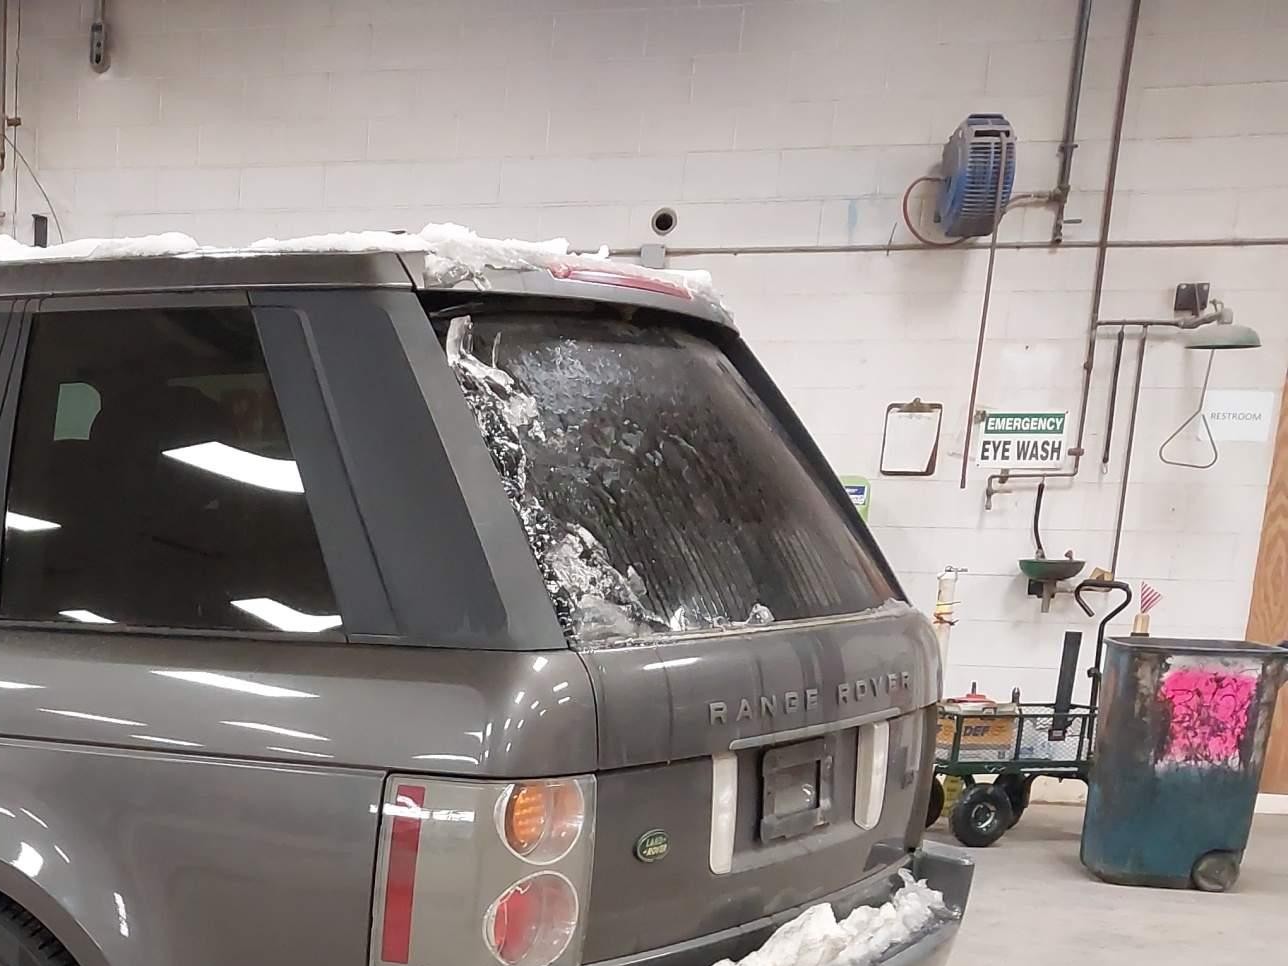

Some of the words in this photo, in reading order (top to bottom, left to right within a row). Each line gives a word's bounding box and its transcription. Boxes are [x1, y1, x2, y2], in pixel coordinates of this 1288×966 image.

[986, 416, 1064, 432] EMERGENCY
[1210, 411, 1262, 422] RESTROOM
[980, 440, 1010, 461] EYE
[1015, 439, 1062, 461] WASH
[709, 688, 819, 726] RANGE
[837, 671, 910, 705] ROVER
[963, 725, 991, 737] DEF
